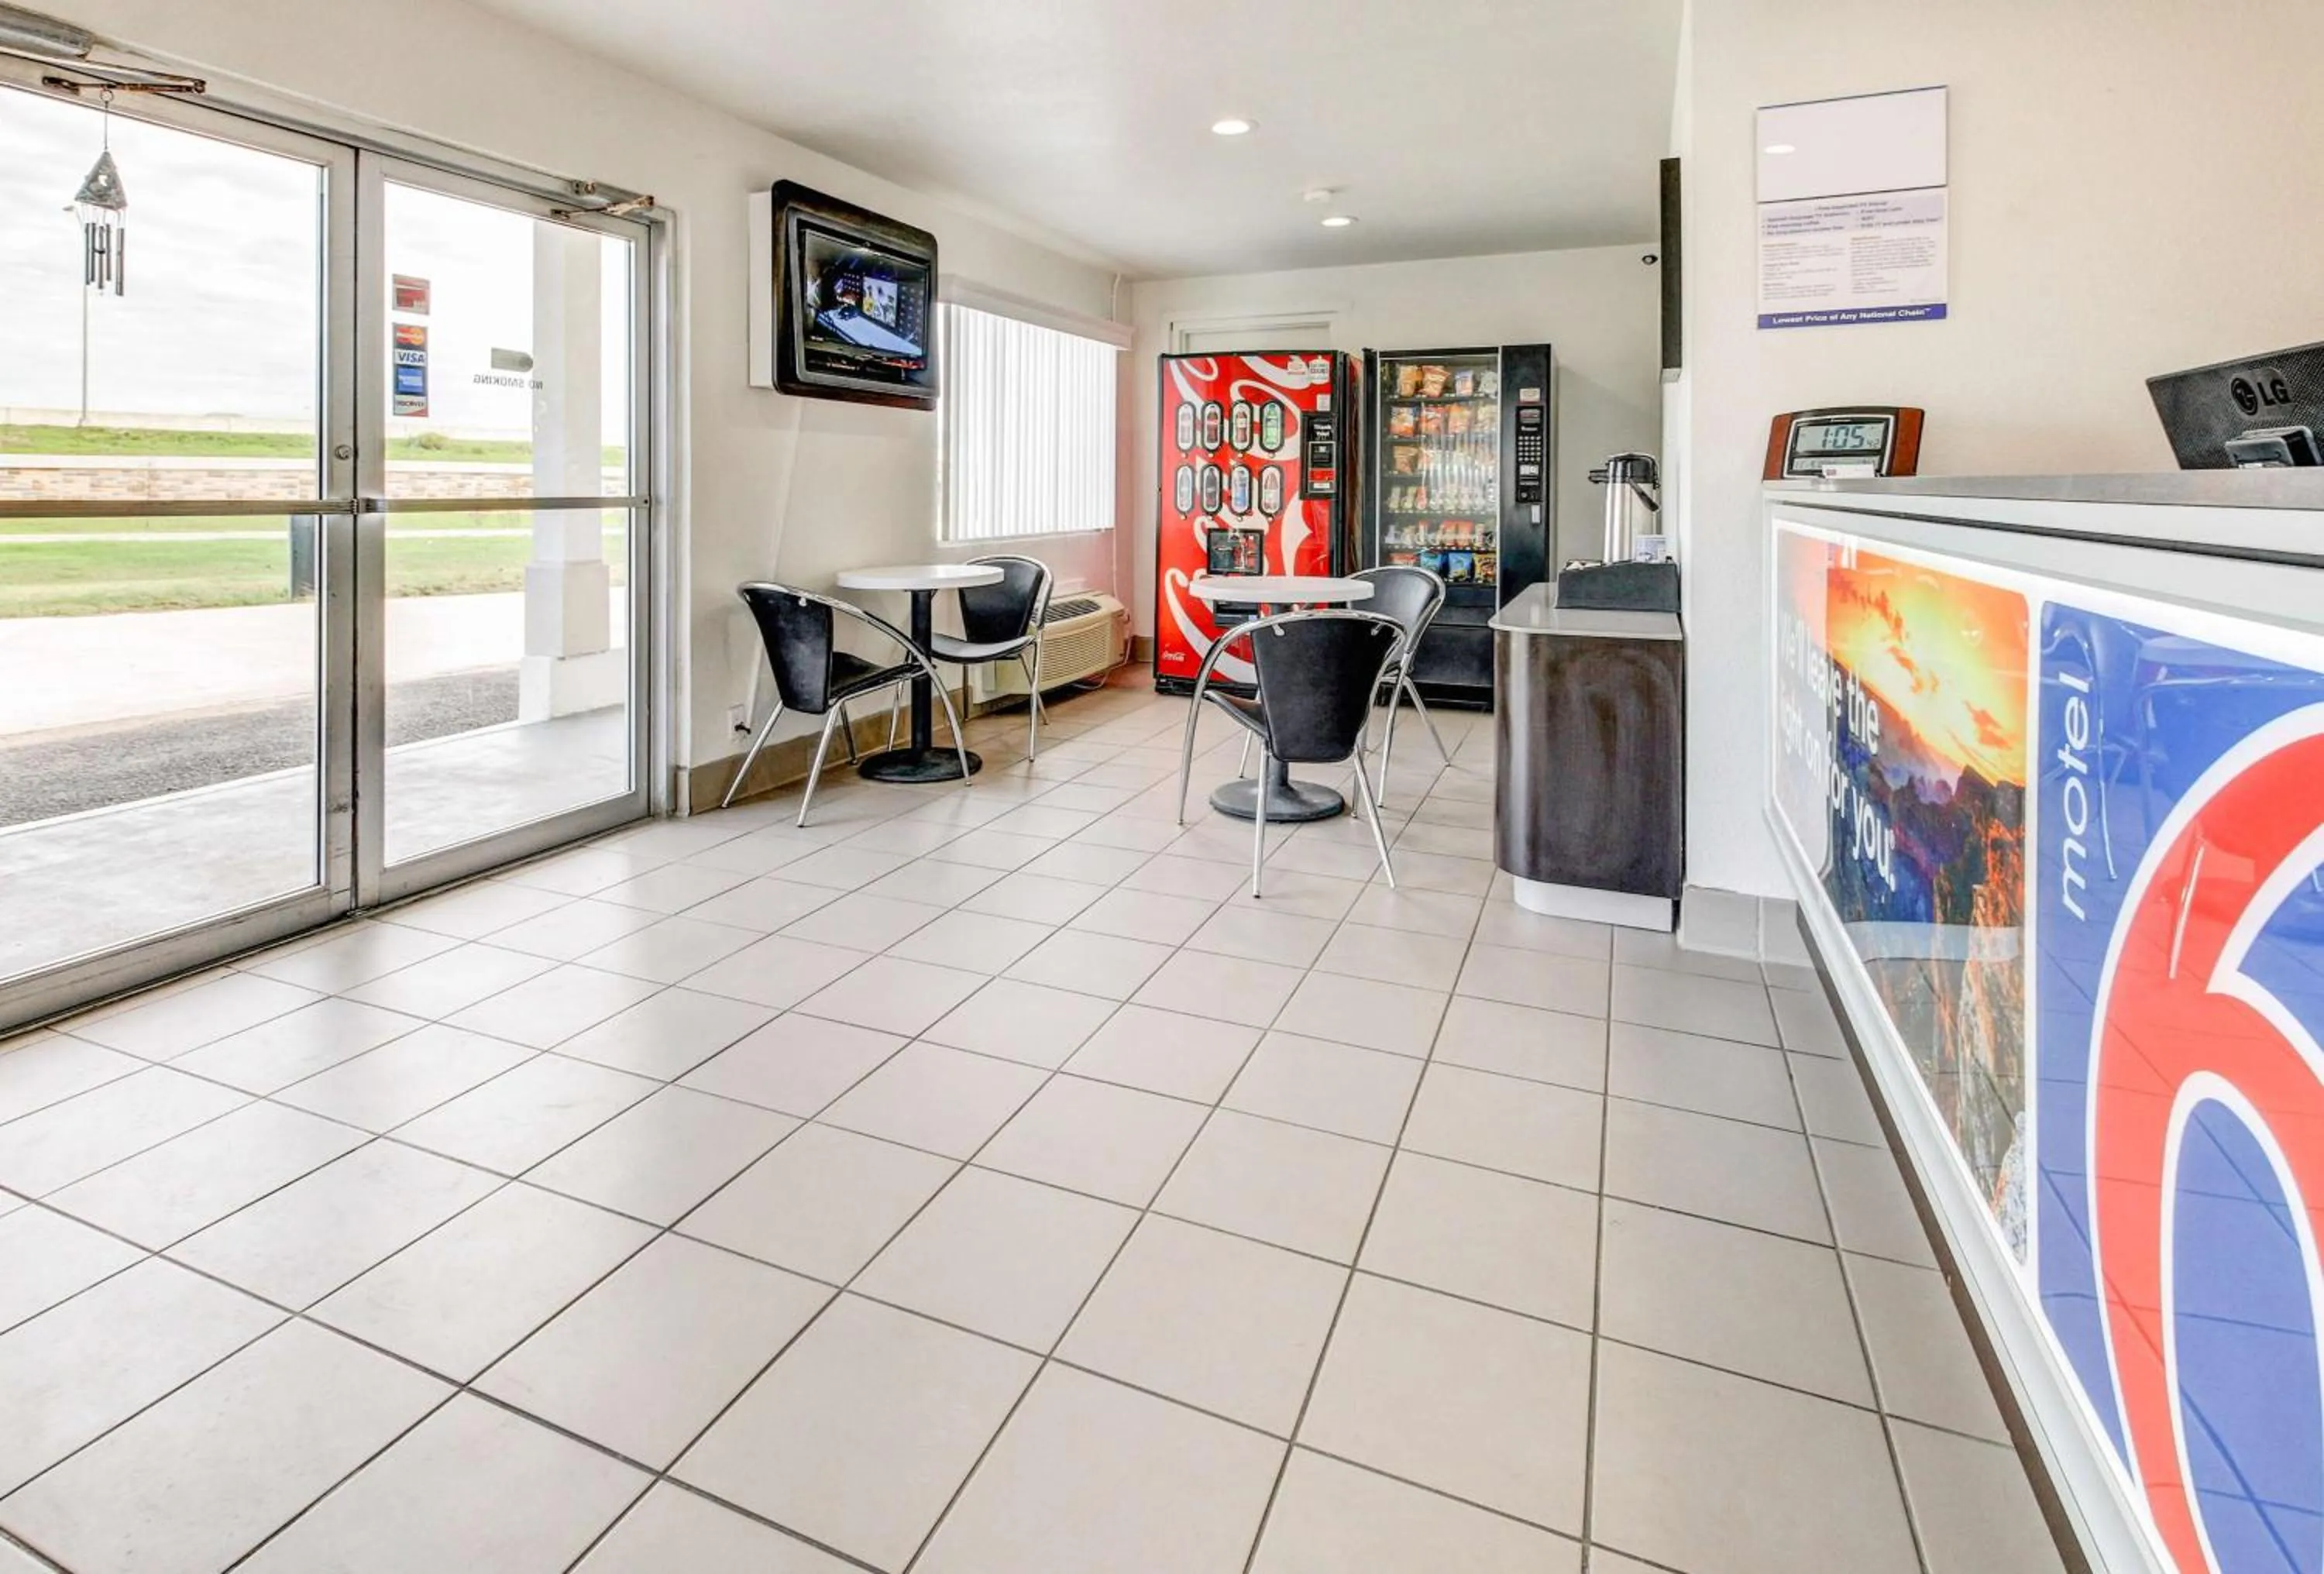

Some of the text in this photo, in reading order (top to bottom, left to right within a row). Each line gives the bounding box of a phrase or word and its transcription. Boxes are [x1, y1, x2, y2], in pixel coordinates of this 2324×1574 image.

[1772, 316, 1803, 325] Lowest
[1841, 313, 1858, 321] Any
[1859, 311, 1896, 319] National
[398, 352, 425, 363] VISA
[1822, 426, 1865, 448] 1:05
[1848, 668, 1879, 756] the
[2058, 672, 2091, 922] motel
